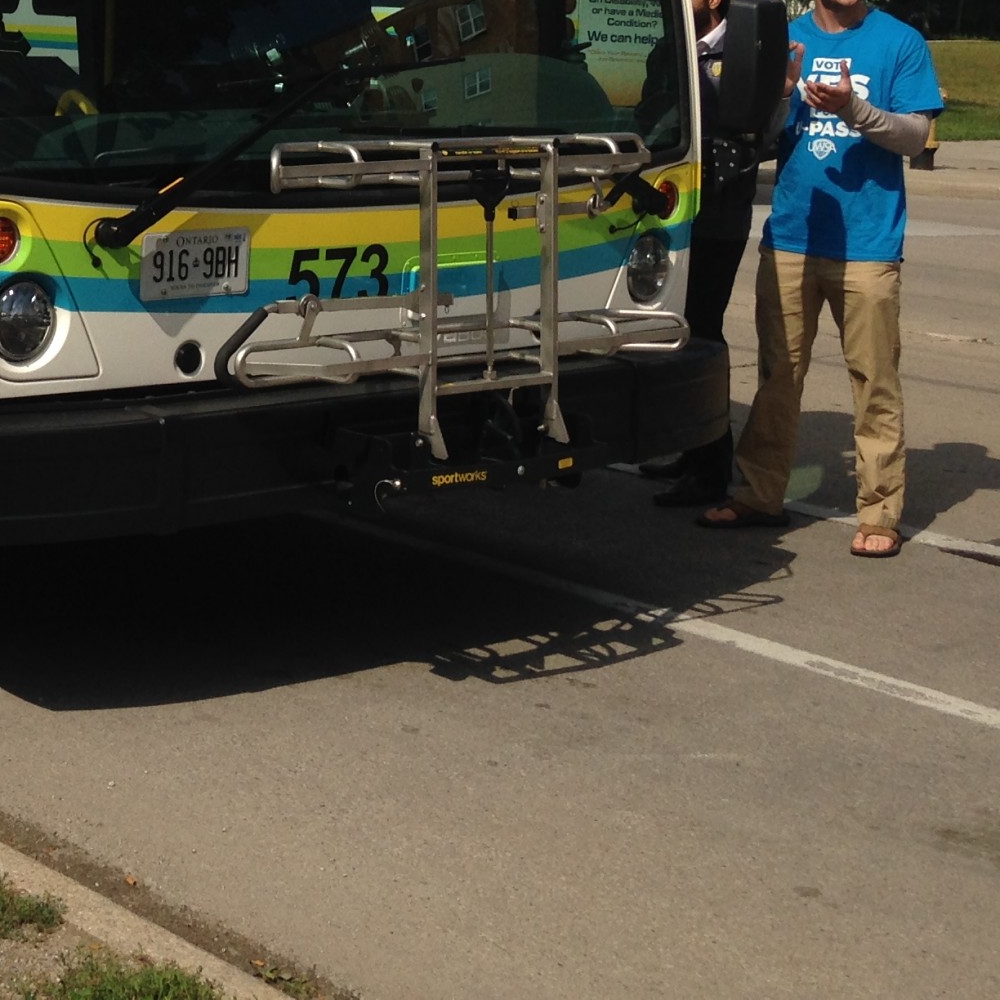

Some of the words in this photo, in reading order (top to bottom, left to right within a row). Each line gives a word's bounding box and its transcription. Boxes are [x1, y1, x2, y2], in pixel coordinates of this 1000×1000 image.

[592, 7, 603, 15] or
[604, 8, 627, 17] have
[606, 17, 658, 29] Condition?
[587, 30, 608, 42] We
[610, 33, 632, 44] can
[176, 235, 219, 248] ONTARIO
[152, 249, 190, 283] 916
[286, 243, 390, 299] 573
[431, 470, 488, 487] sportworks
